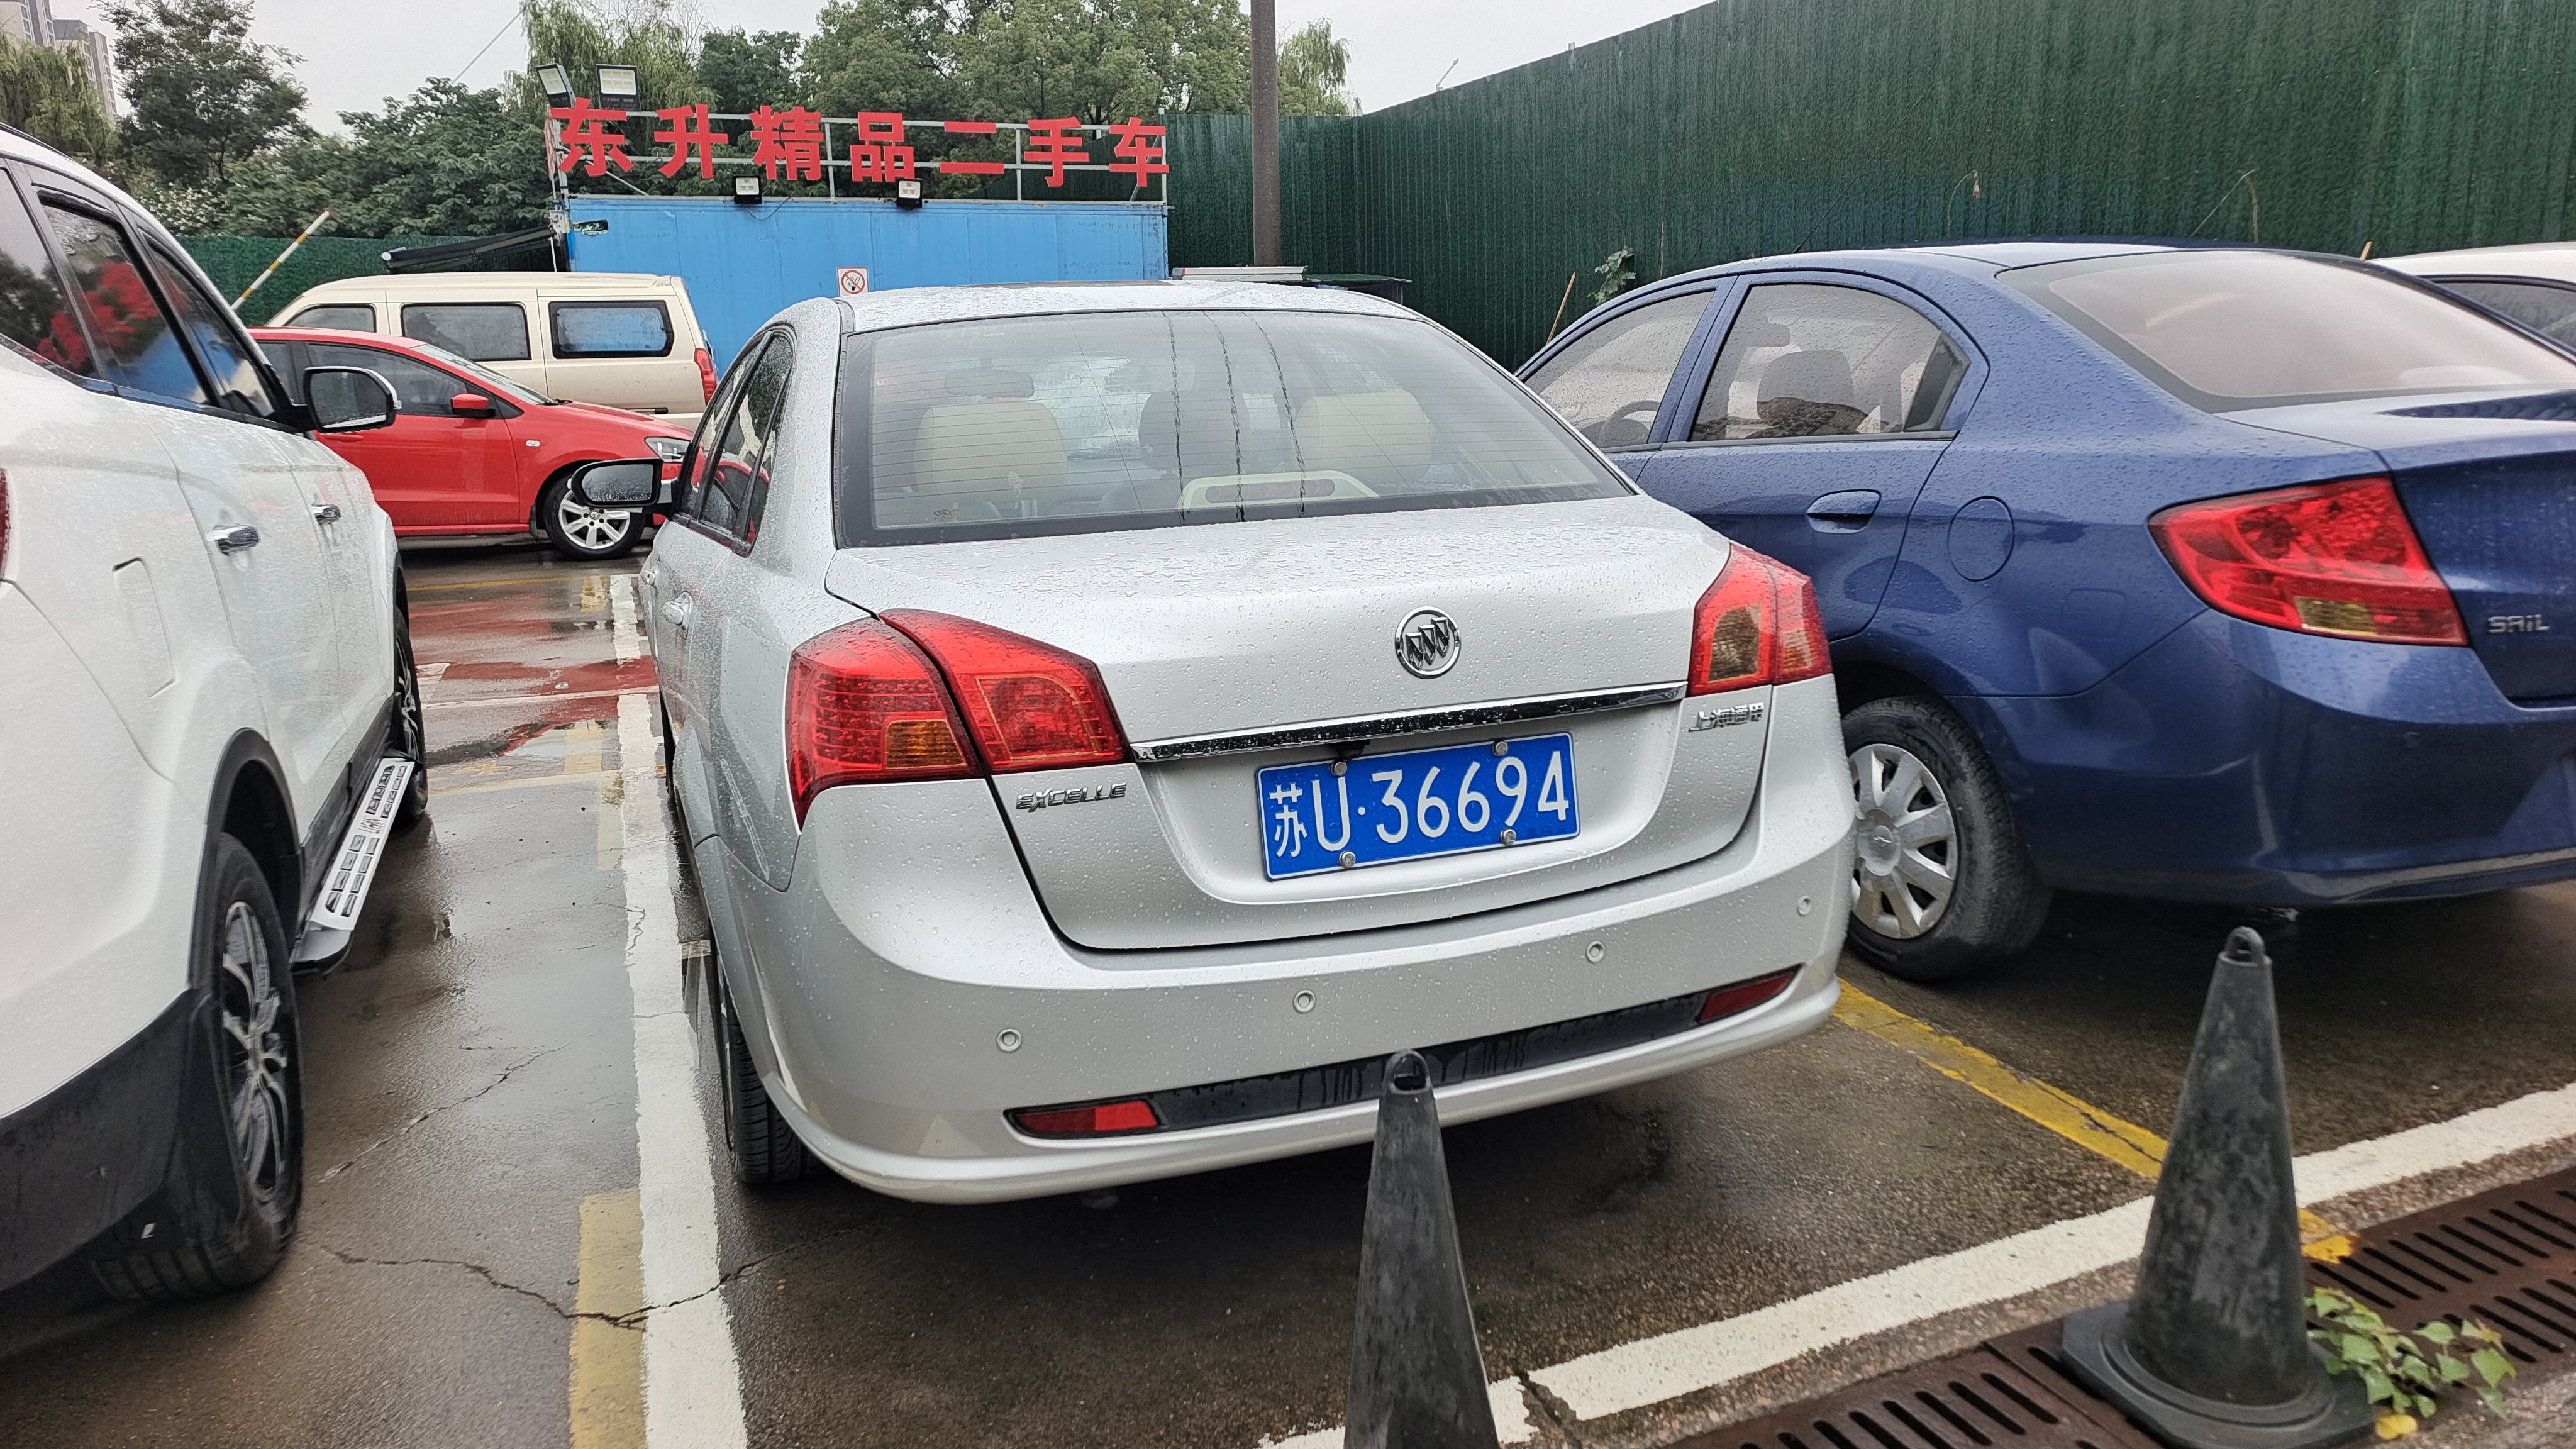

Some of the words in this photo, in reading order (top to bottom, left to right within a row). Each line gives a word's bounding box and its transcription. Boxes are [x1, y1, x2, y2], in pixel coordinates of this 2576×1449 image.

[551, 97, 1169, 188] 东升精品二手车
[1016, 781, 1127, 813] EXCELLE
